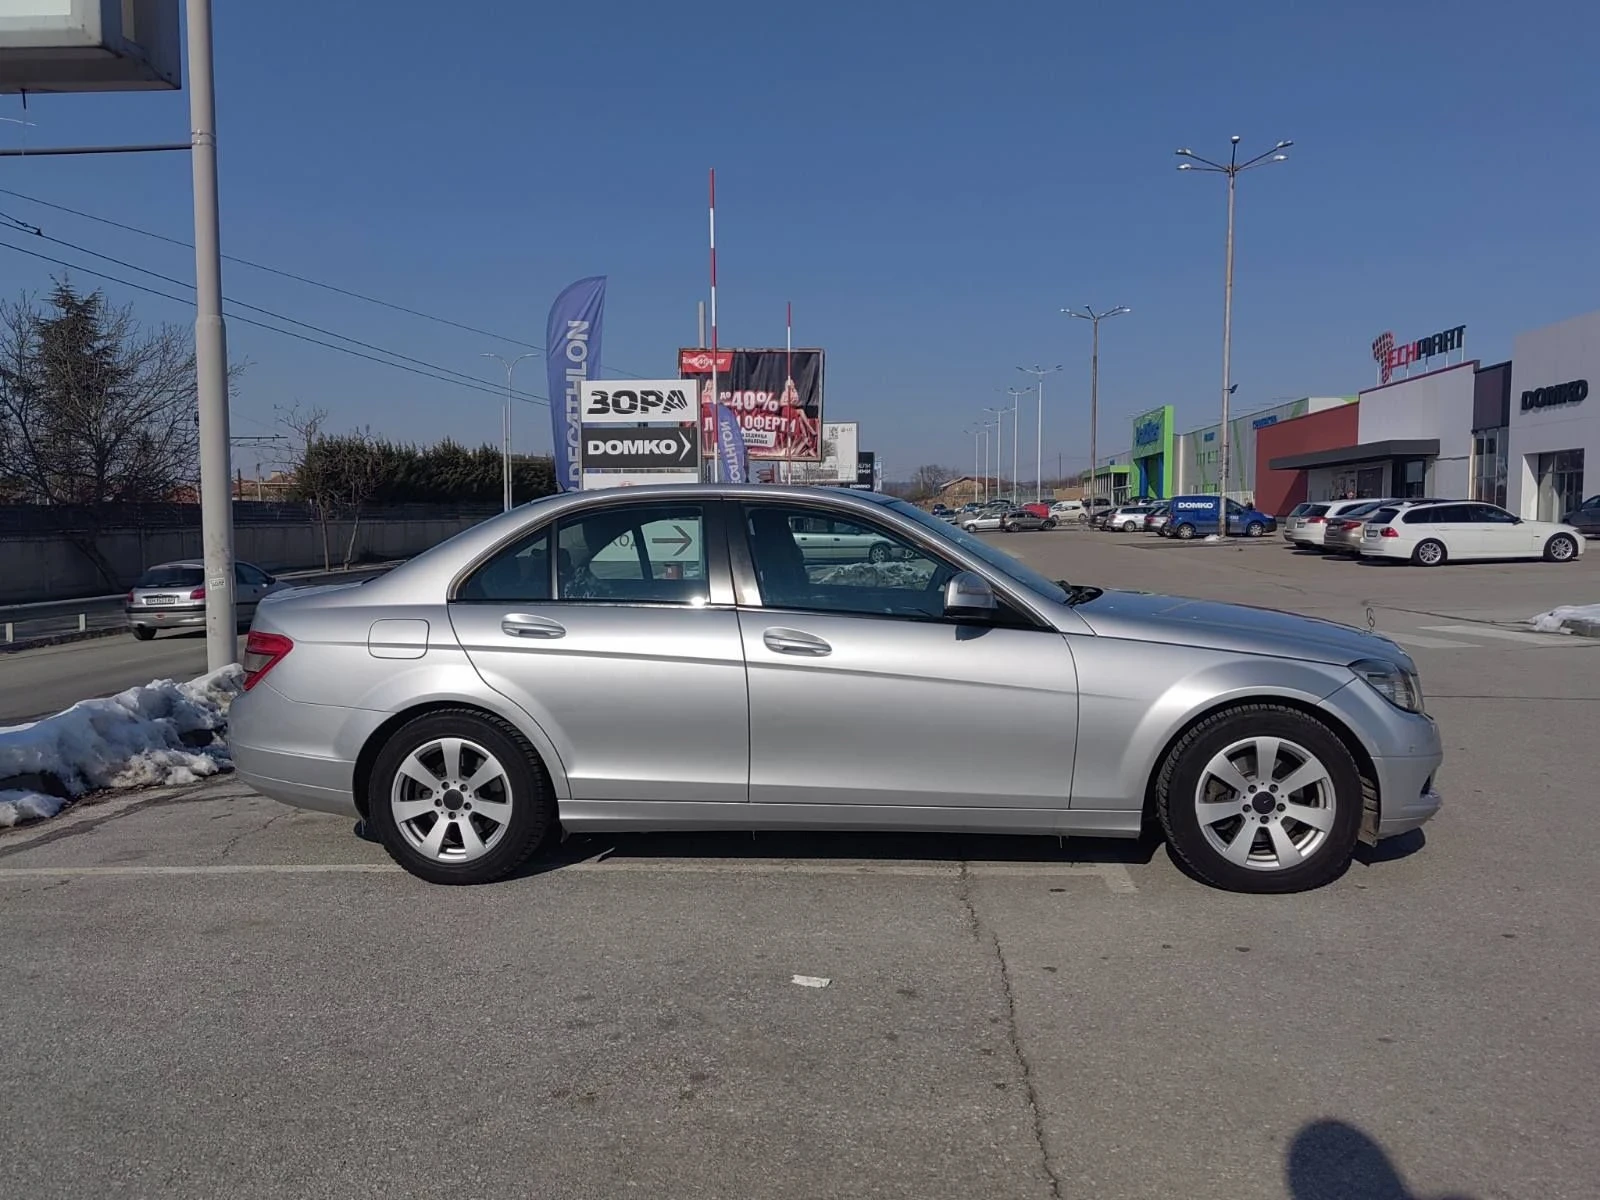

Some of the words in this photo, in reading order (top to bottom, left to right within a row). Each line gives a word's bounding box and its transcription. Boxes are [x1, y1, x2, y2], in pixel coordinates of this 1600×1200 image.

[587, 390, 688, 415] ЗОРА
[1521, 379, 1588, 410] DOMKO
[587, 439, 677, 455] DOMKO
